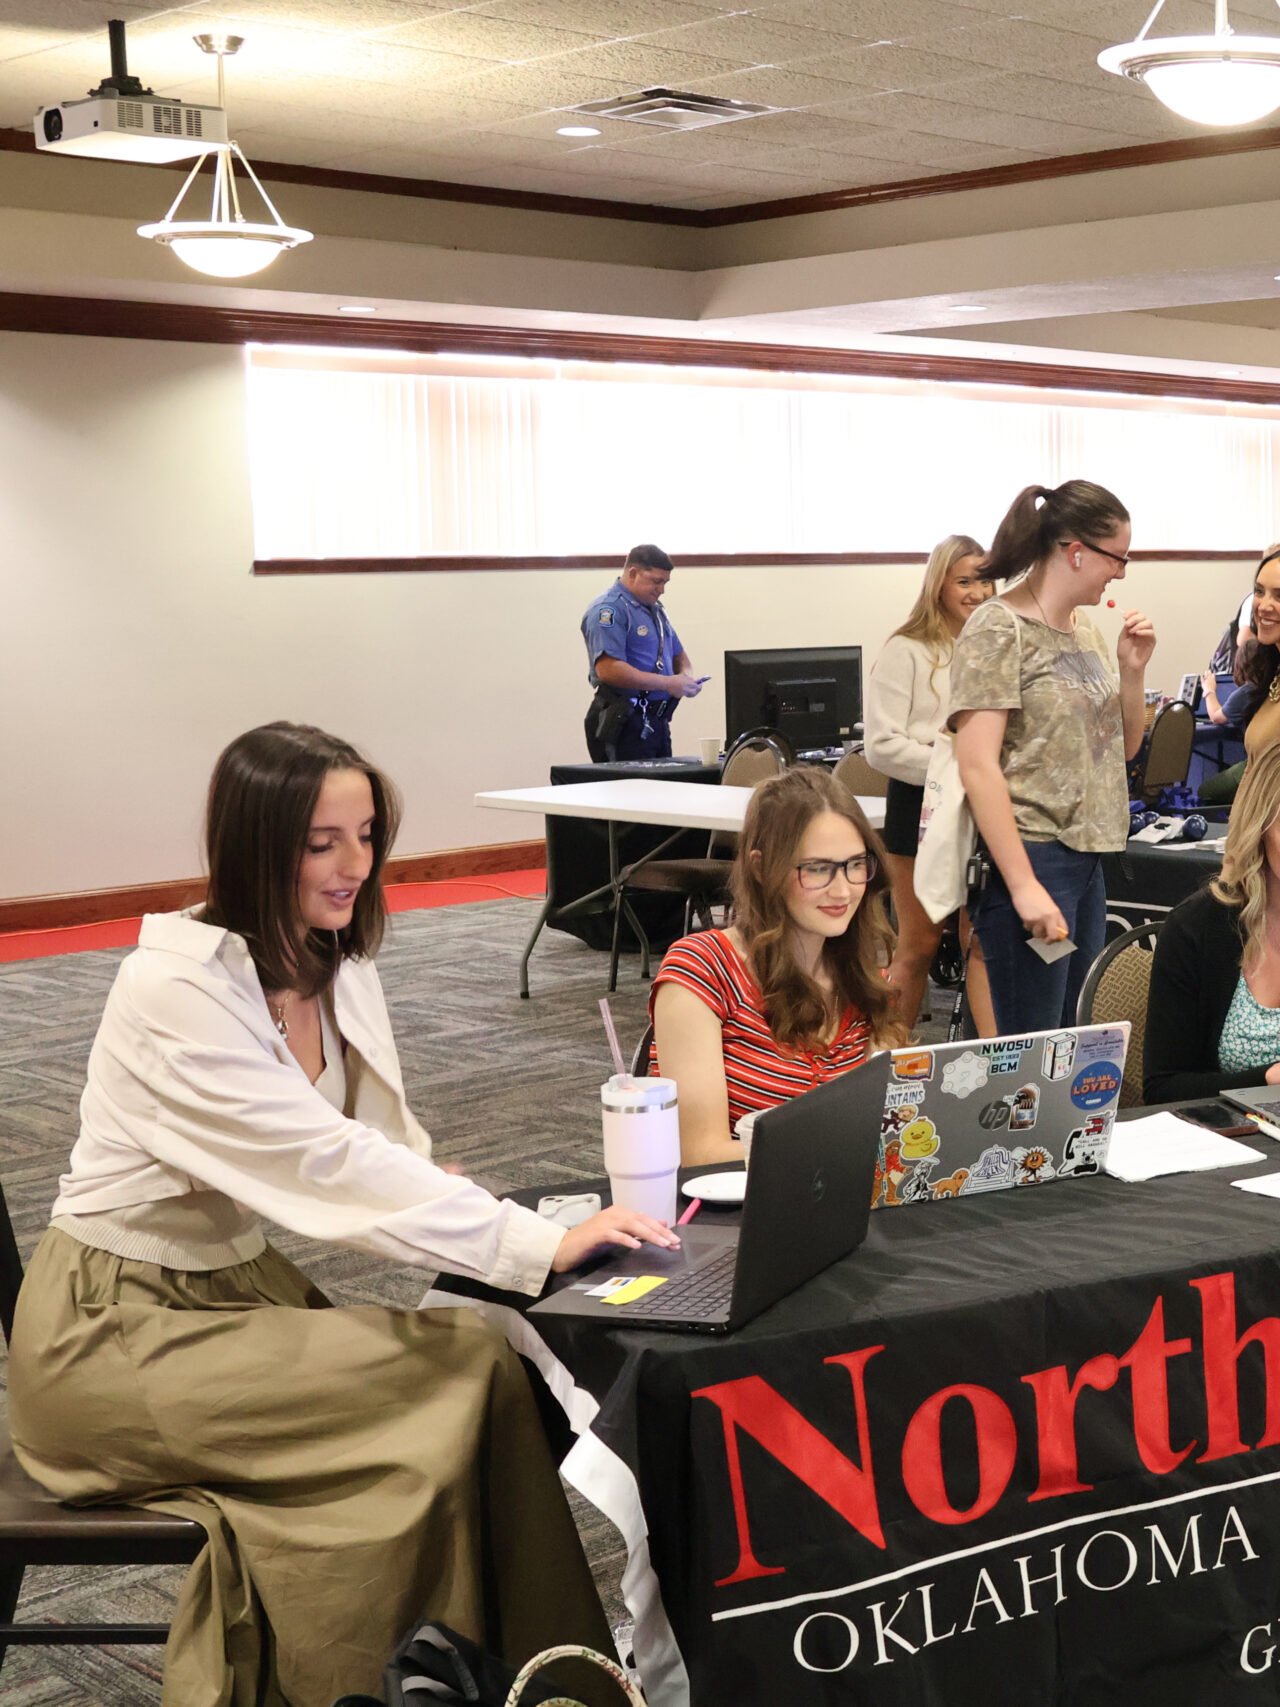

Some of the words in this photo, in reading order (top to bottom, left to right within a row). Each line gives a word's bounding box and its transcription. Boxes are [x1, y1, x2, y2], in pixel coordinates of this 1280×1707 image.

[981, 1038, 1034, 1055] NWOSU
[990, 1061, 1018, 1074] BCM
[1073, 1080, 1117, 1096] LOVED
[792, 1506, 1260, 1673] OKLAHOMA
